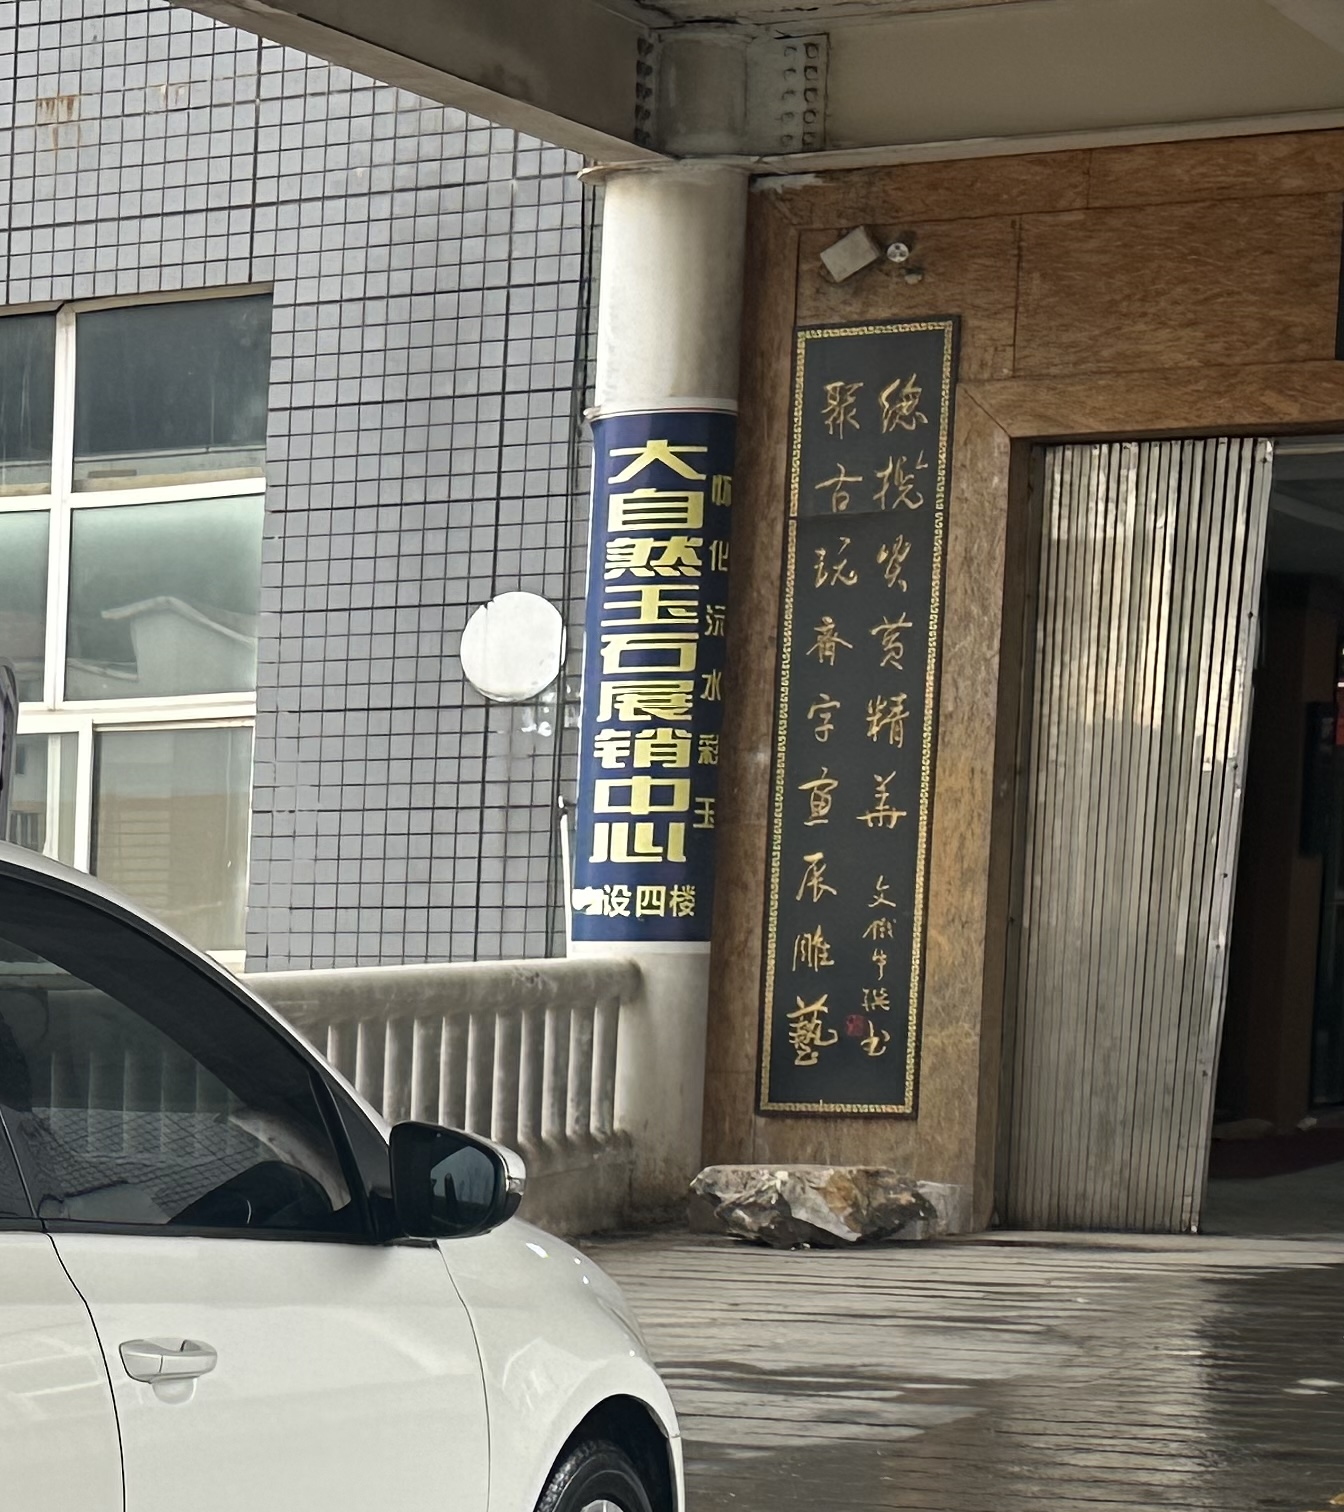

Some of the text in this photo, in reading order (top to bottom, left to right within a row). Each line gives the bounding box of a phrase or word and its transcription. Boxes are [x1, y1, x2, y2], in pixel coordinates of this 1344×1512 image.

[589, 439, 708, 863] 大自然玉石展销中心
